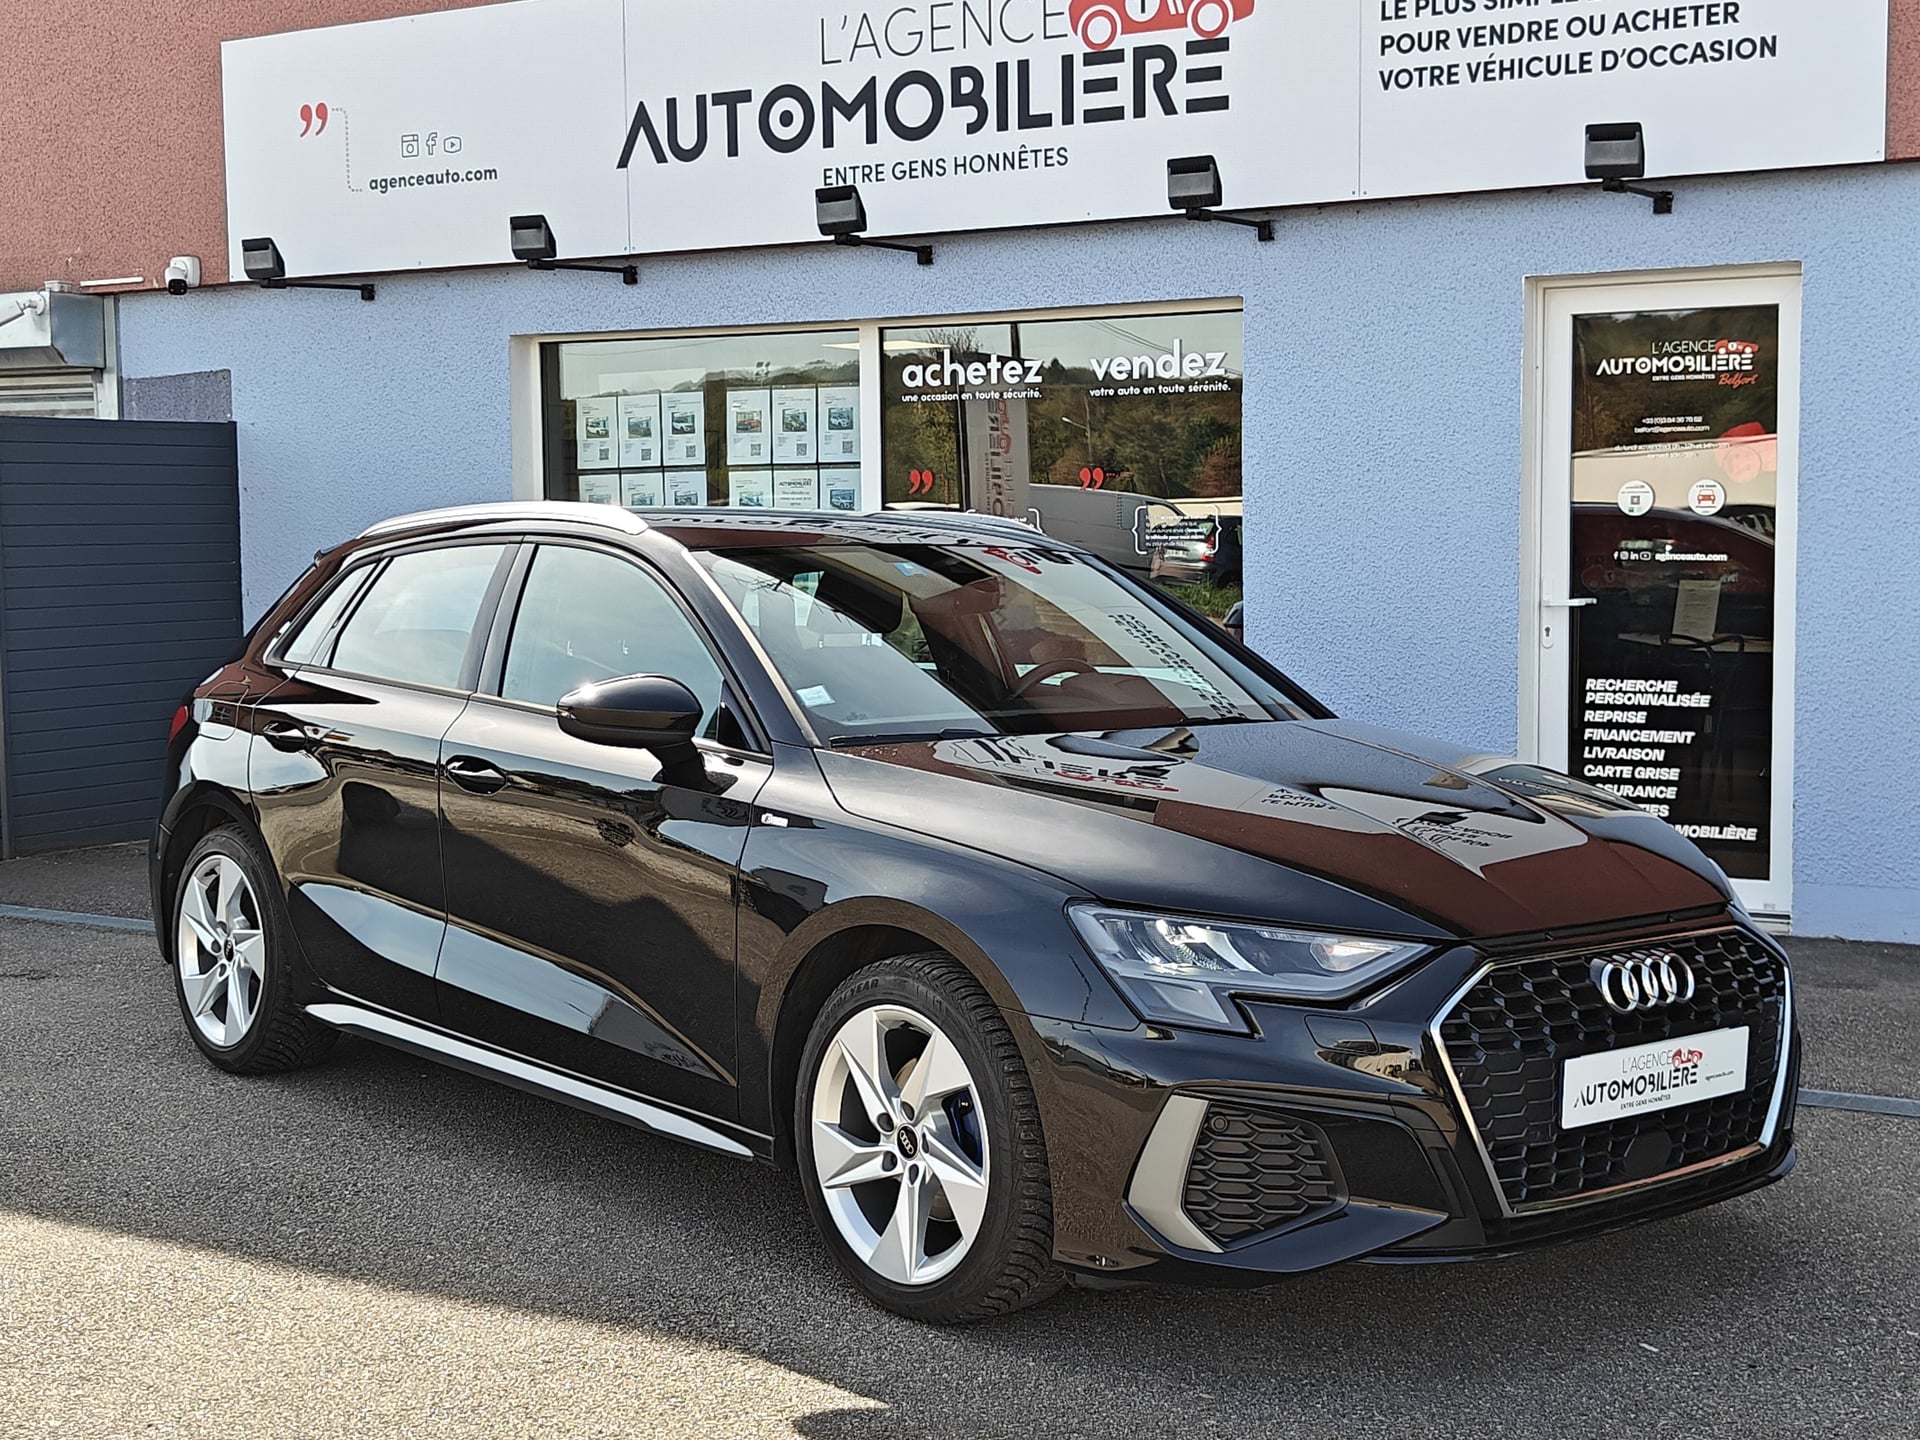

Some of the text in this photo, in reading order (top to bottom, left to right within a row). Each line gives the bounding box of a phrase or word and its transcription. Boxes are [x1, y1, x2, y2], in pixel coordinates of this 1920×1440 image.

[1381, 0, 1407, 21] LE
[820, 0, 1068, 65] L'AGENCE
[1380, 1, 1740, 56] POUR VENDRE OU ACHETER
[1378, 34, 1777, 91] VOTRE VÉHICULE D'OCCASION
[823, 144, 1069, 187] ENTRE GENS HONNÊTES
[369, 168, 498, 195] agenceauto.com
[1651, 340, 1716, 354] L'AGENCE
[902, 348, 1043, 388] achetez
[1089, 338, 1227, 382] vendez
[901, 387, 1043, 402] une occasion en toute sécurité.
[1089, 380, 1232, 397] votre auto en toute sérénité.
[1585, 679, 1678, 692] RECHERCHE
[1585, 692, 1711, 707] PERSONNALISÉE
[1584, 710, 1647, 723] REPRISE
[1584, 729, 1695, 744] FINANCEMENT
[1583, 746, 1665, 761] LIVRAISON
[1583, 765, 1681, 781] CARTE GRISE
[1595, 784, 1678, 800] SURANCE
[1668, 824, 1758, 841] MOBILIÈRE
[1621, 1050, 1673, 1074] L'AGENCE
